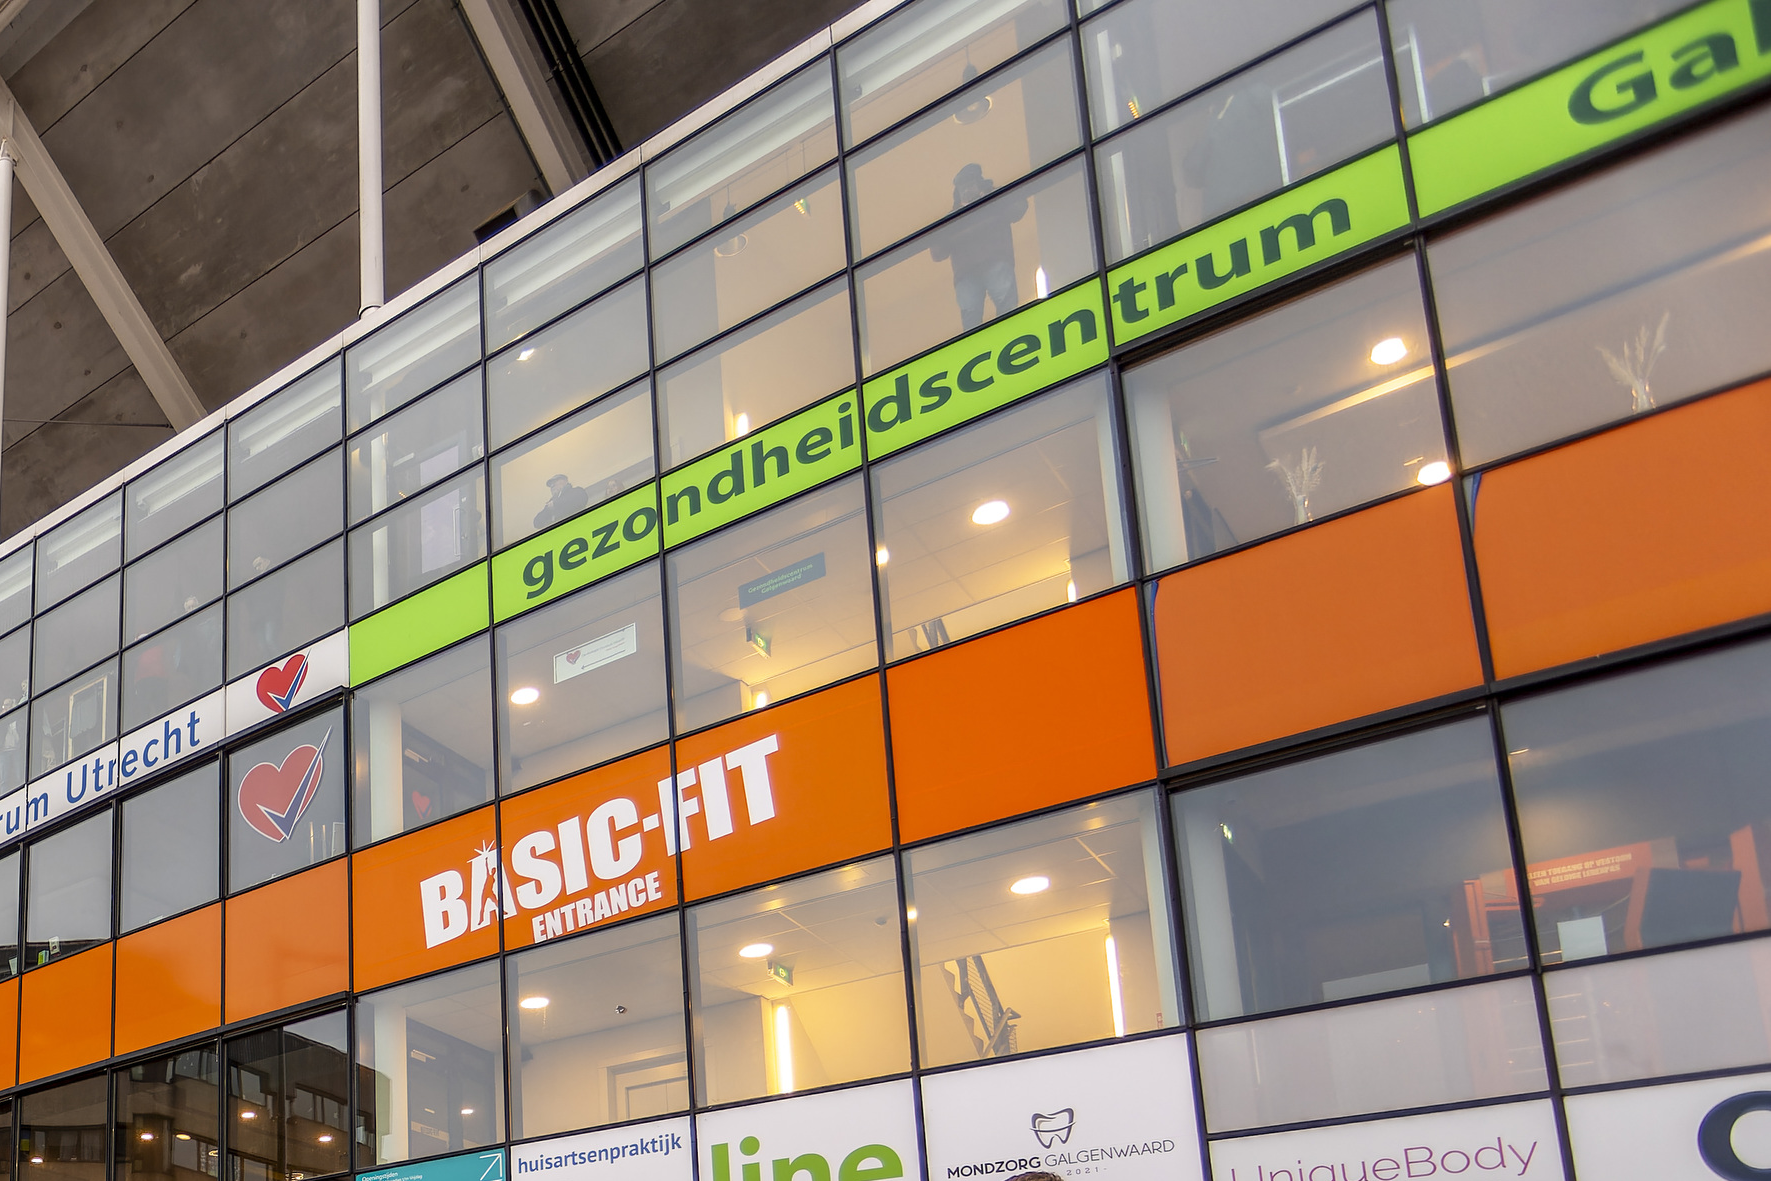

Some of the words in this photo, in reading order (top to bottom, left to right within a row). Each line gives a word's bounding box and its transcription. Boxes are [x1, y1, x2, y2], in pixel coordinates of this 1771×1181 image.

[521, 197, 1351, 600] gezondheidscentrum
[66, 711, 201, 803] Utrecht
[420, 734, 779, 948] BASIC-FIT
[532, 871, 662, 943] ENTRANCE
[518, 1133, 682, 1173] huisartsenpraktijk
[947, 1157, 1041, 1179] MONDZORG
[1045, 1139, 1175, 1167] GALGENWAARD
[1066, 1166, 1099, 1176] 2021
